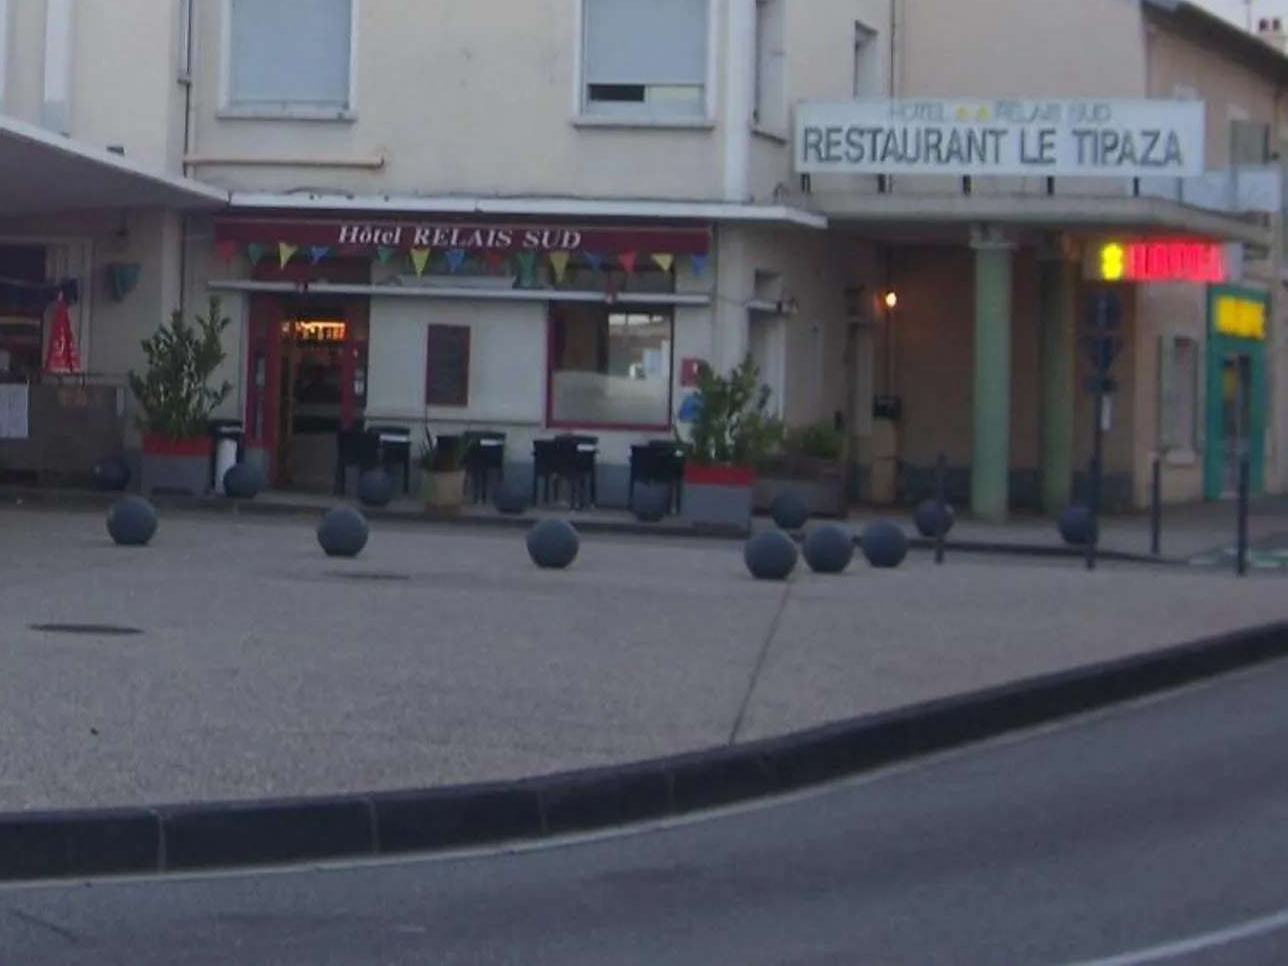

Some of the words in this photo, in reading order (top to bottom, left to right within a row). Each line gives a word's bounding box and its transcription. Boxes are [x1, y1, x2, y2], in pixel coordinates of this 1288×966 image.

[803, 126, 1008, 165] RESTAURANT
[1018, 128, 1057, 165] LE
[1071, 129, 1185, 167] TIPAZA
[337, 223, 402, 245] Hôtel
[413, 226, 513, 248] RELAIS
[522, 229, 582, 250] SUD
